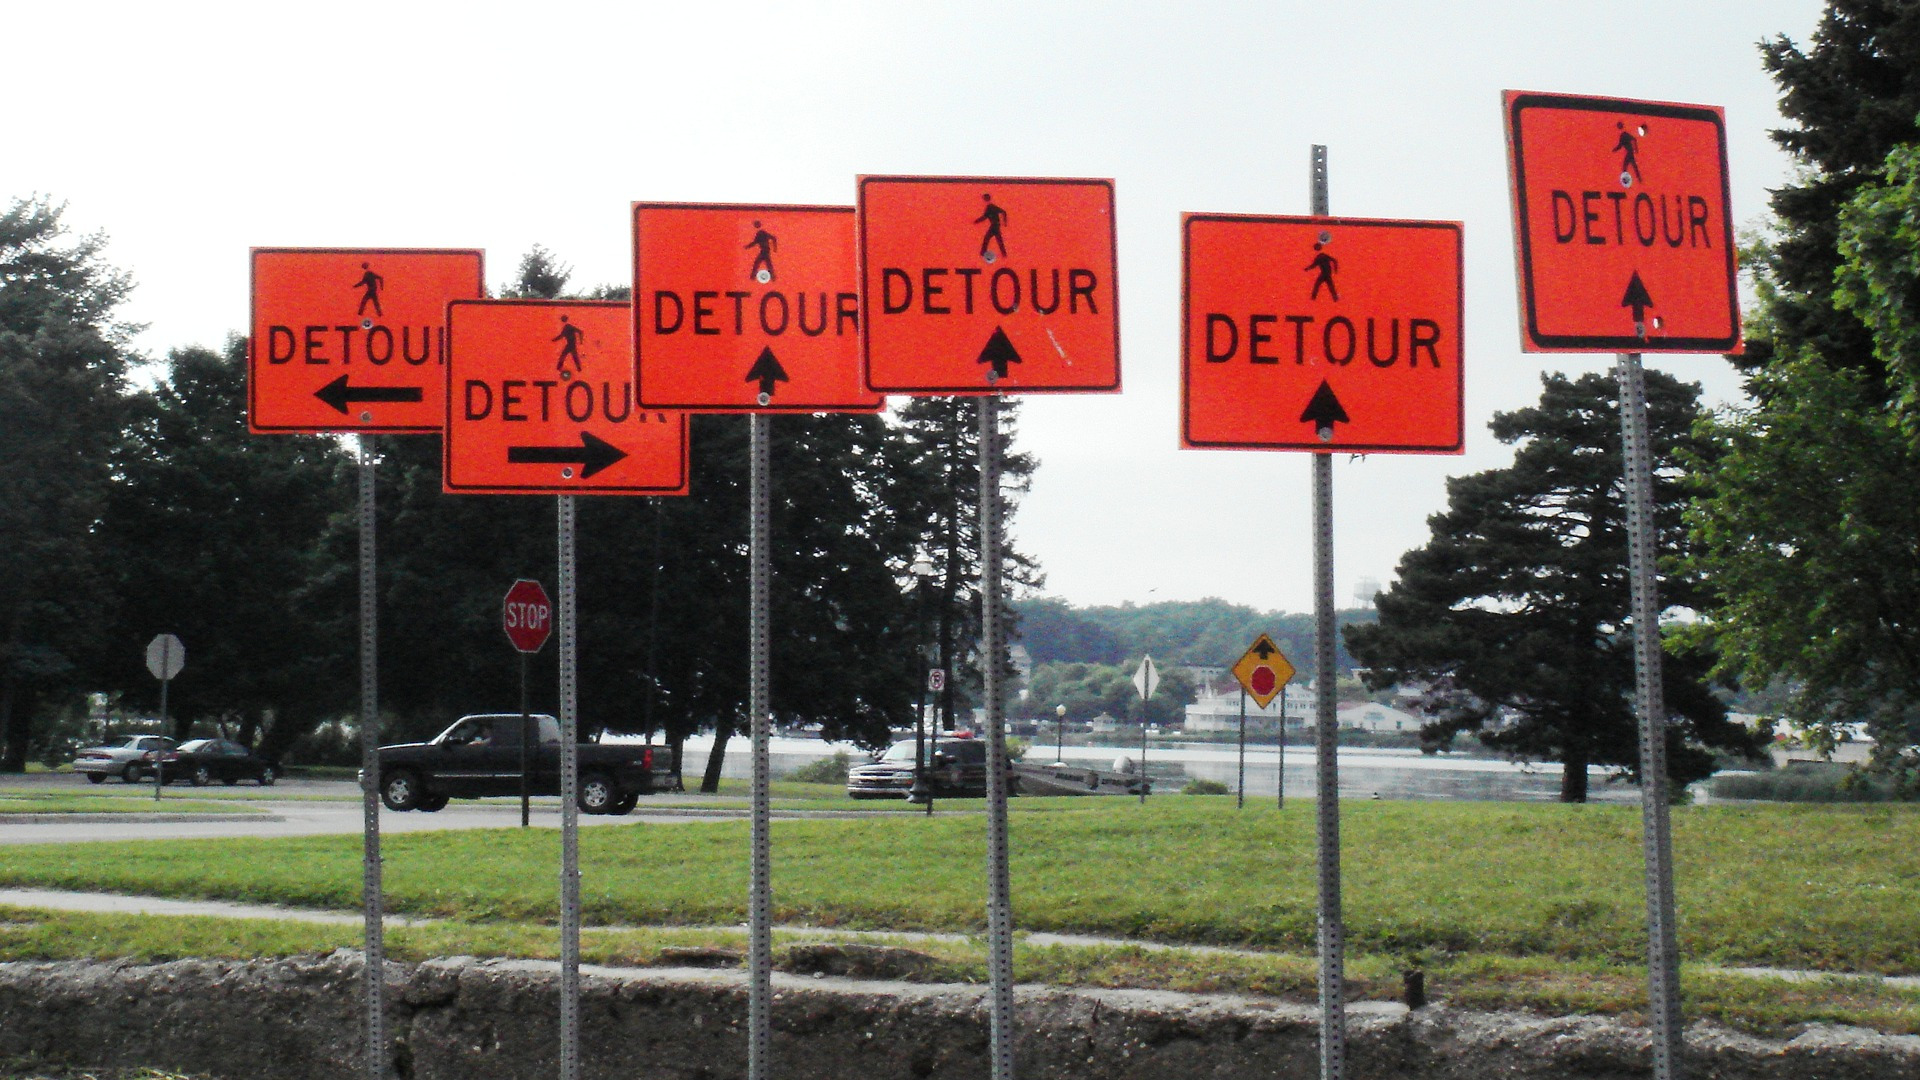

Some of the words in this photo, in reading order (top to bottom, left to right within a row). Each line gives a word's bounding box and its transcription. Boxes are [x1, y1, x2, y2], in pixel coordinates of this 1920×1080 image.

[1551, 190, 1711, 248] DETOUR
[655, 290, 859, 336] DETOUR
[883, 267, 1098, 315] DETOUR
[268, 325, 444, 366] DETOU
[1205, 313, 1442, 368] DETOUR
[465, 379, 667, 423] DETOU
[507, 602, 548, 629] STOP
